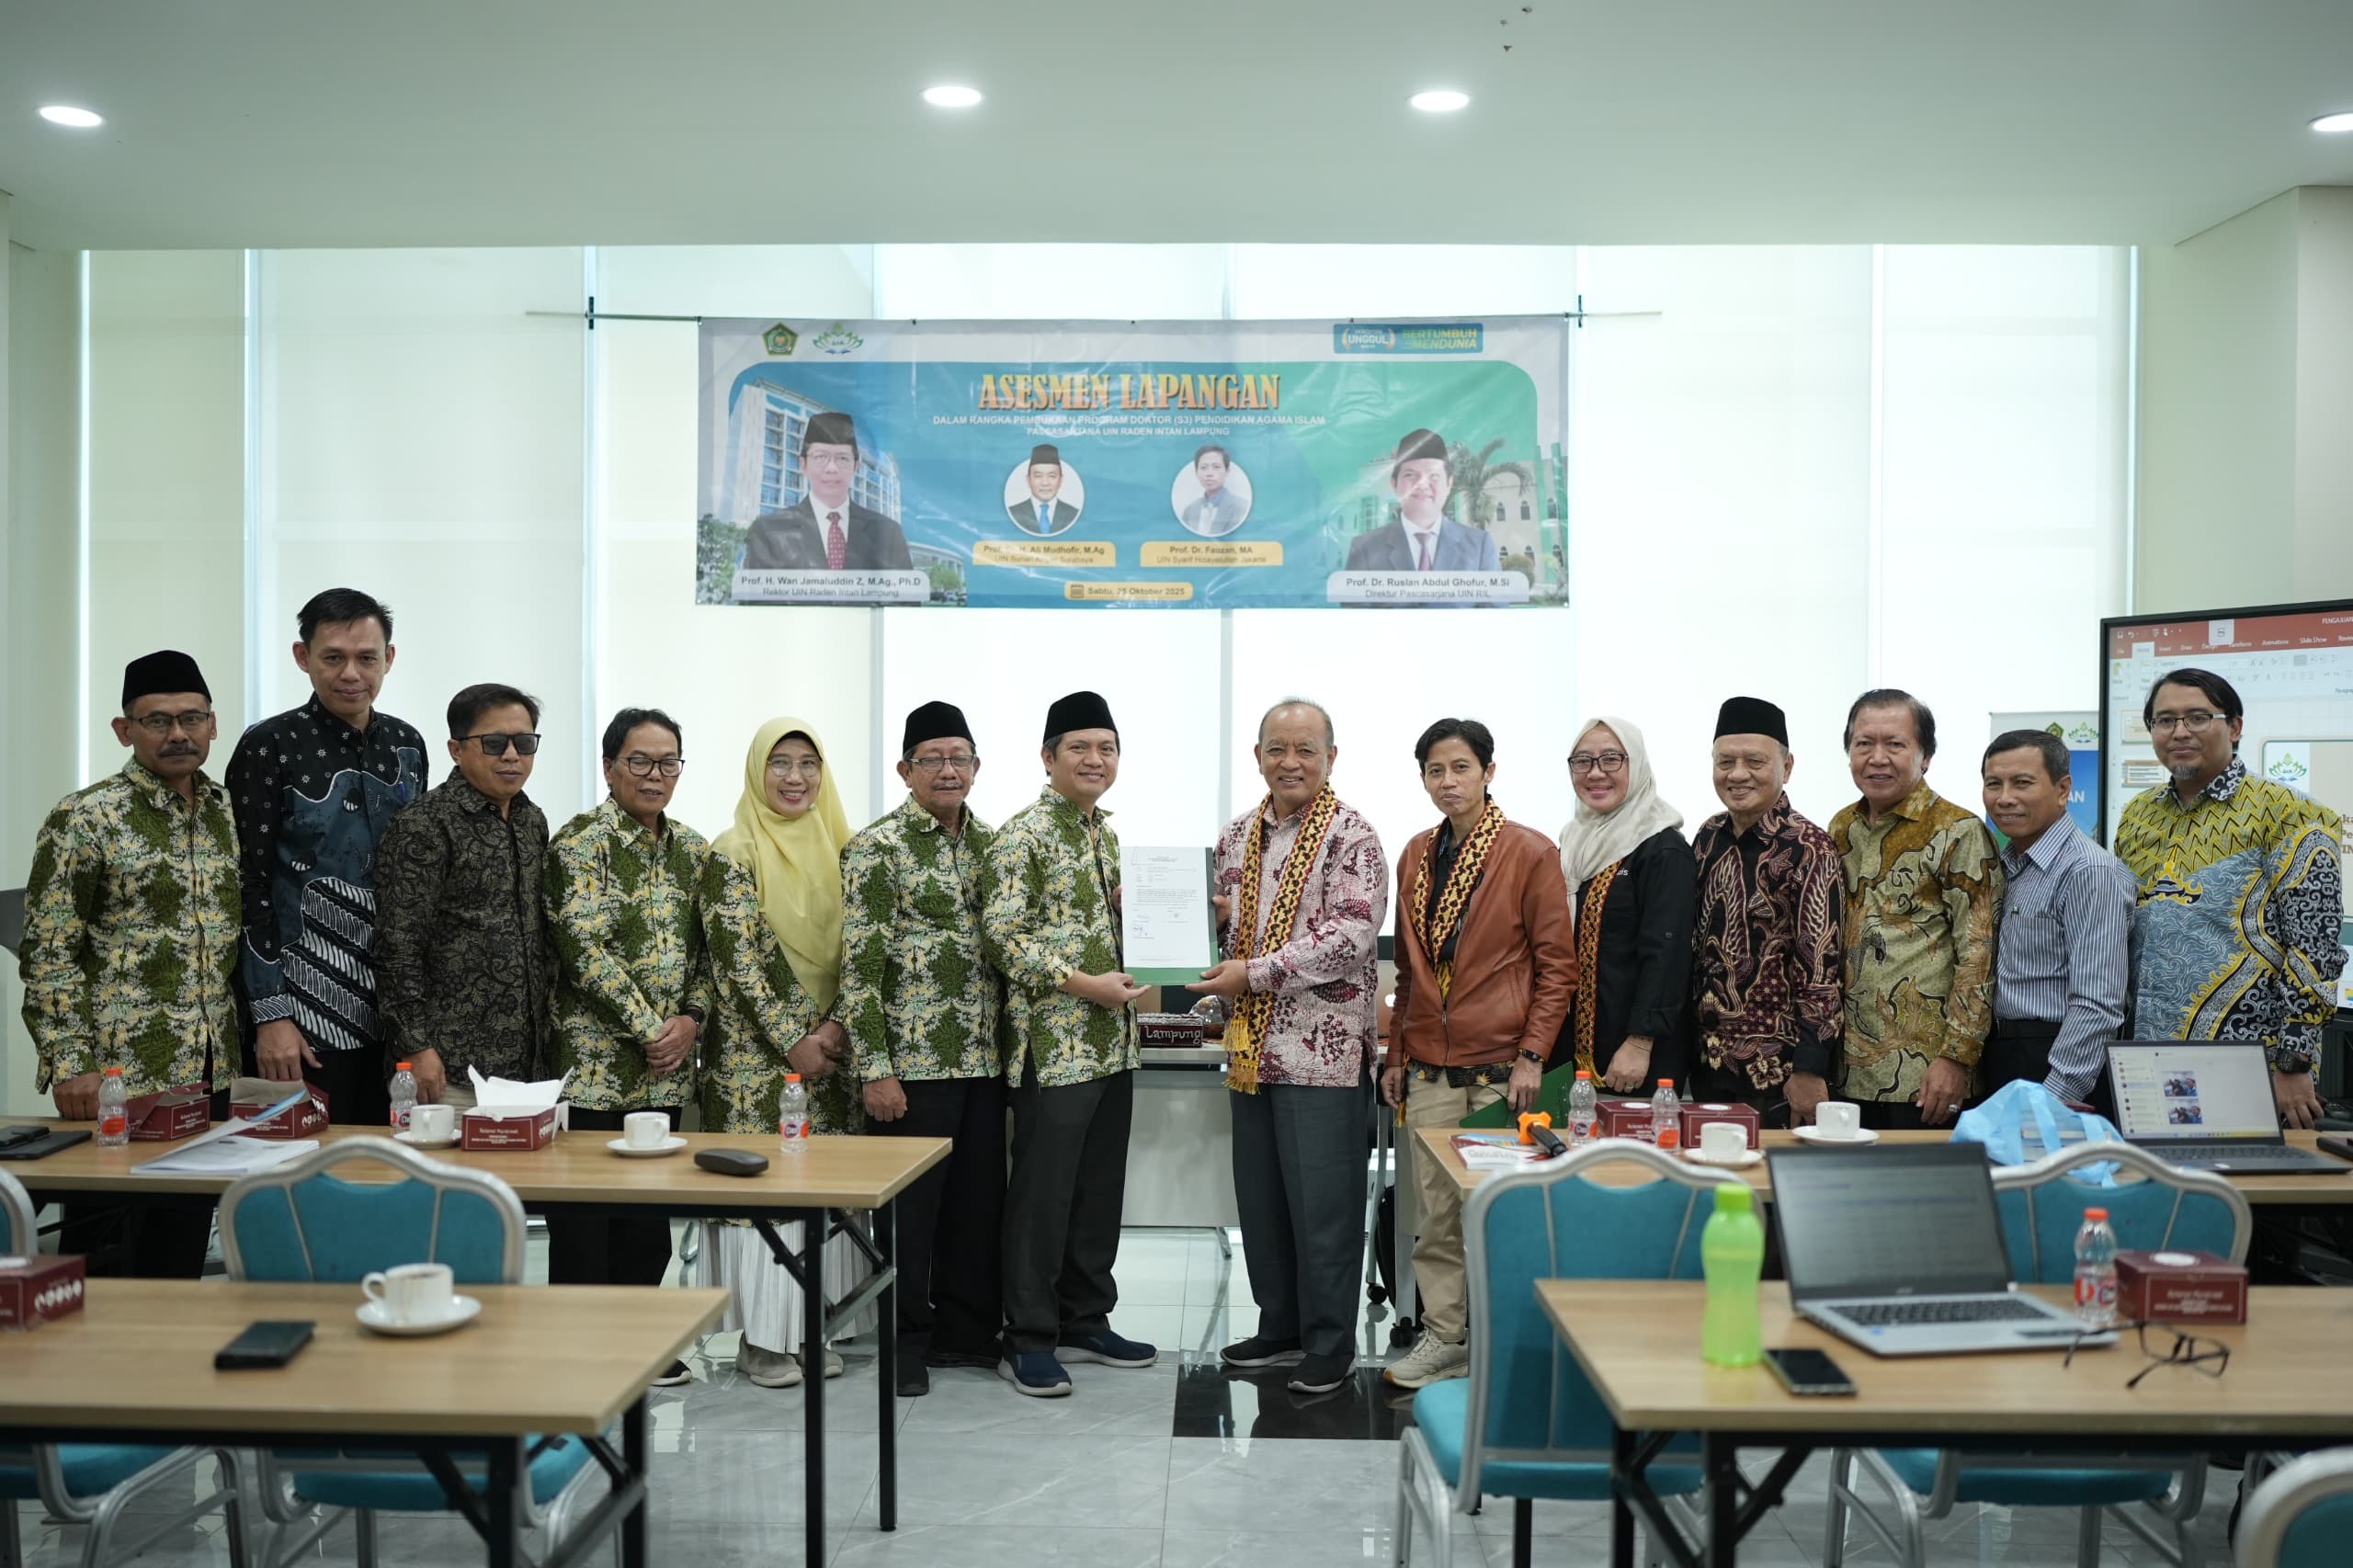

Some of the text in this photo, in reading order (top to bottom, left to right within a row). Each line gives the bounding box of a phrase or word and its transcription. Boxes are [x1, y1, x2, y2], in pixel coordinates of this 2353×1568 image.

[1402, 329, 1478, 339] BERTUMBUH
[1347, 335, 1389, 345] UNGGUL
[977, 373, 1280, 411] ASESMEN LAPANGAN
[933, 415, 966, 426] DALAM
[970, 415, 1012, 426] RANGKA
[1079, 415, 1128, 426] PROGRAM
[1130, 415, 1172, 426] DOKTOR
[1174, 415, 1193, 426] (S3)
[1195, 415, 1256, 426] PENDIDIKAN
[1257, 415, 1293, 426] AGAMA
[1294, 415, 1325, 426] ISLAM
[1103, 426, 1119, 437] UIN
[1120, 426, 1154, 437] RADEN
[1154, 426, 1182, 437] INTAN
[1184, 426, 1230, 437] LAMPUNG
[1029, 545, 1042, 554] Ali
[1083, 545, 1106, 555] M.Ag
[1169, 545, 1188, 554] Prof.
[1190, 545, 1202, 554] Dr.
[1239, 545, 1254, 554] MA
[741, 575, 763, 586] Prof.
[765, 575, 776, 586] H.
[778, 576, 798, 586] Wan
[800, 576, 854, 586] Jamaluddin
[898, 576, 921, 586] Ph.D
[1346, 577, 1510, 588] Prof. Dr. Ruslan Abdul Ghofur, M.Si
[763, 588, 899, 598] Rektor UIN Raden Intan Lampung
[1129, 587, 1163, 596] Oktober
[1165, 587, 1185, 596] 2025
[1365, 589, 1491, 600] Direktur Pascasarjana UIN RIL
[1143, 1025, 1201, 1045] Lampung
